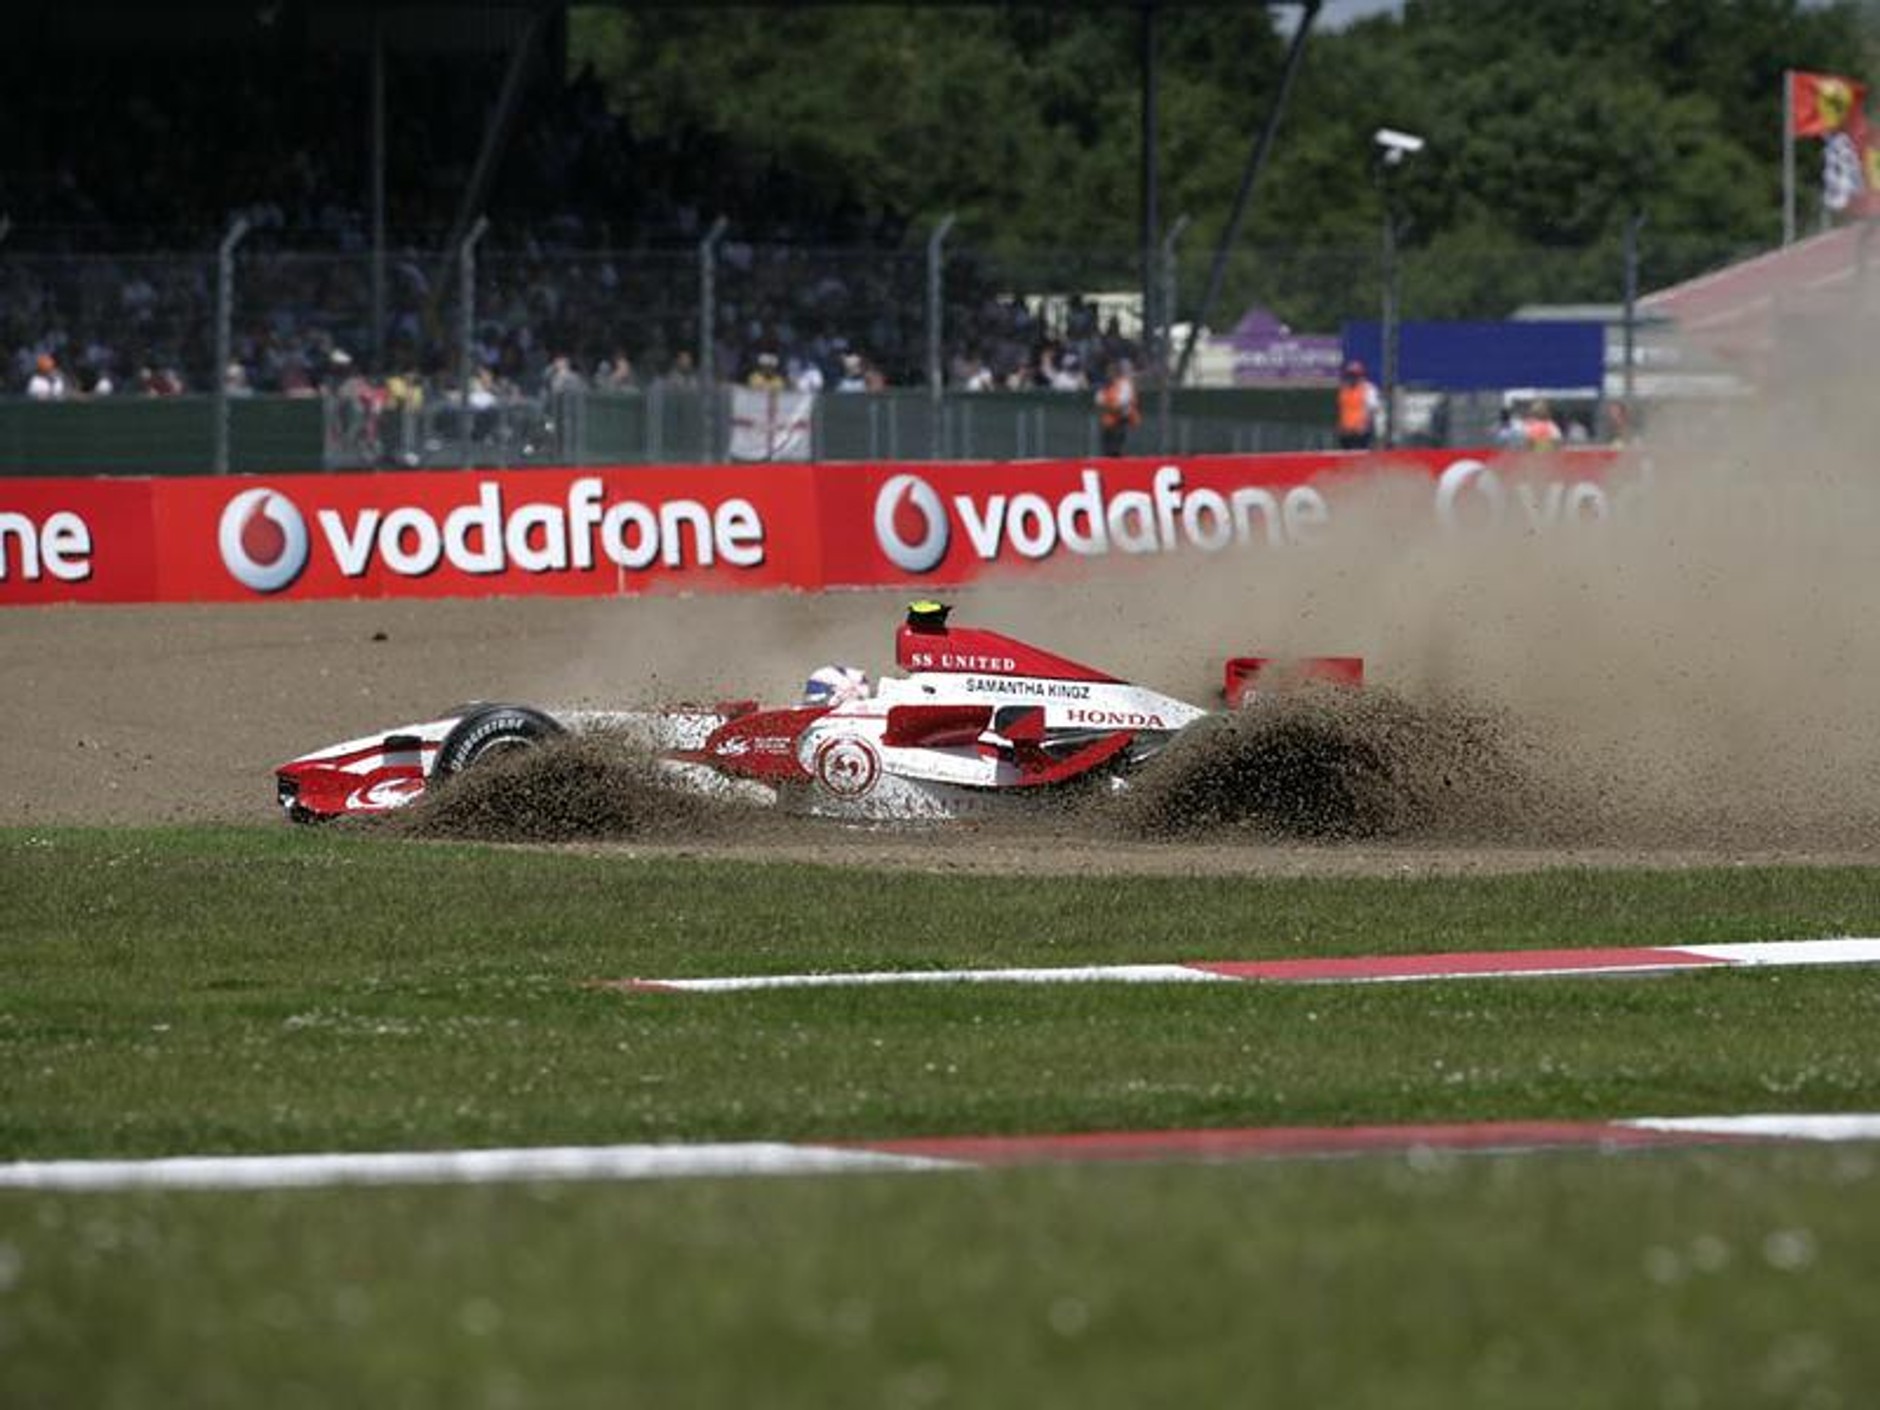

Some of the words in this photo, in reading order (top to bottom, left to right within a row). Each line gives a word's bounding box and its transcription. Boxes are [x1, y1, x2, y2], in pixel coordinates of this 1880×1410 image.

[954, 466, 1329, 558] vodafone
[317, 477, 764, 576] vodafone
[911, 653, 932, 666] SS
[941, 654, 1015, 671] UNITED
[966, 678, 1044, 697] SAMANTHA
[1048, 685, 1090, 700] KINGZ
[1066, 709, 1165, 728] HONDA
